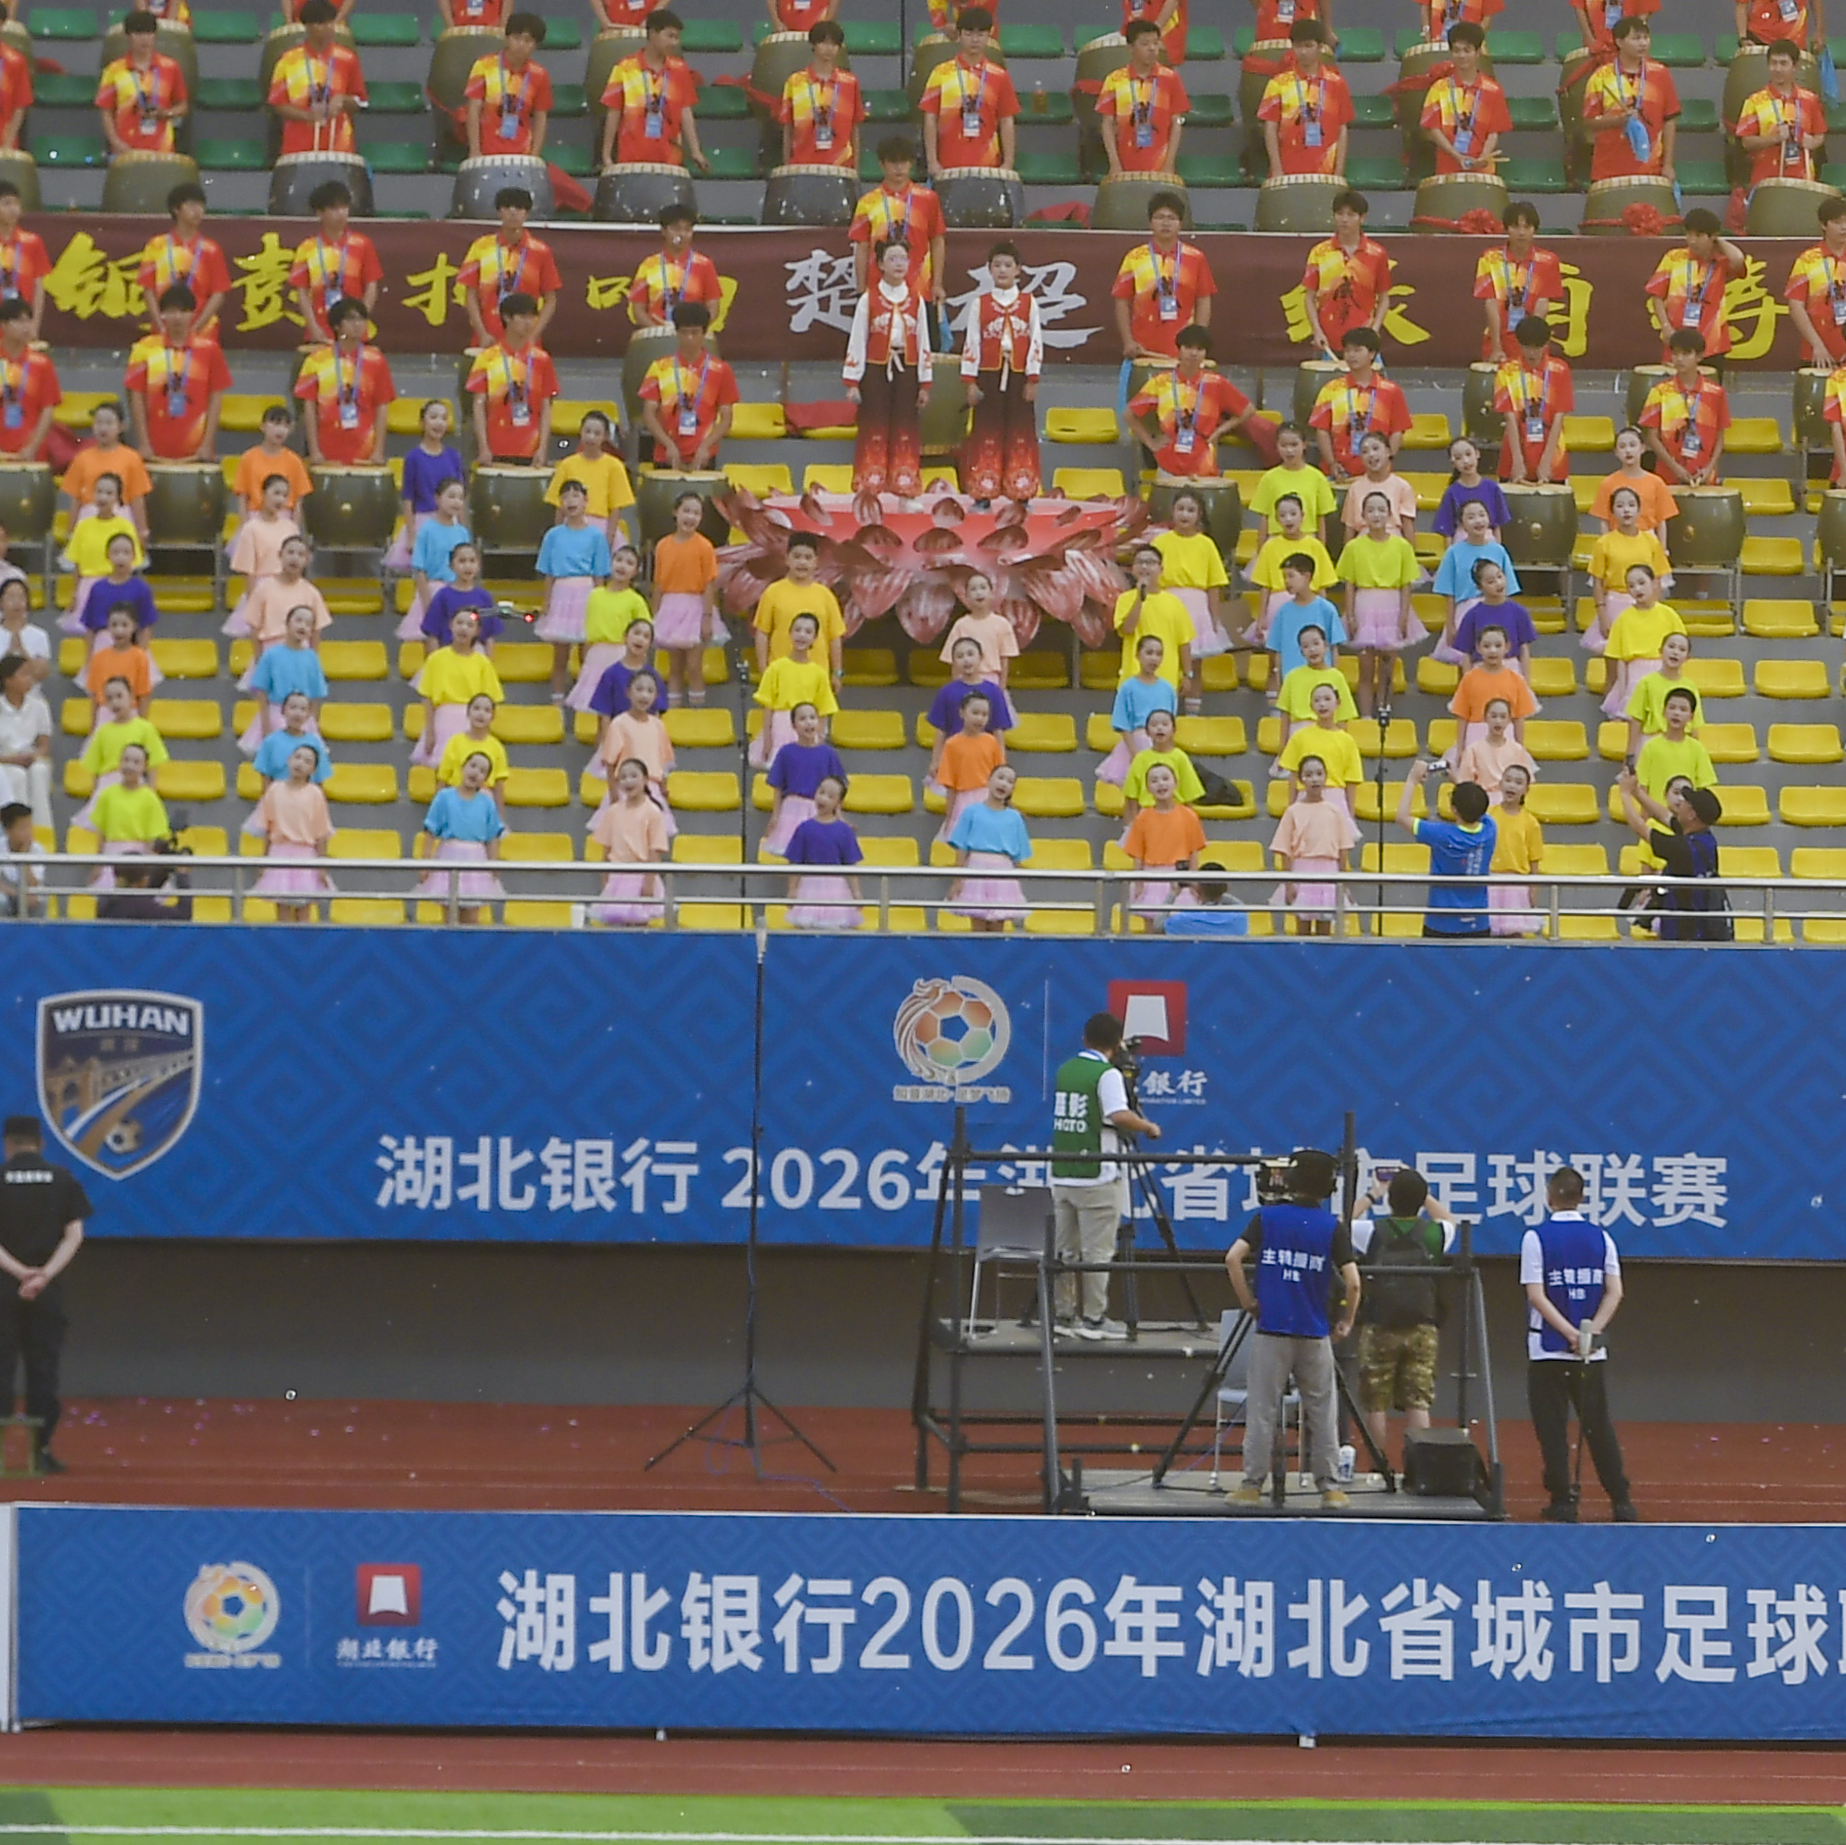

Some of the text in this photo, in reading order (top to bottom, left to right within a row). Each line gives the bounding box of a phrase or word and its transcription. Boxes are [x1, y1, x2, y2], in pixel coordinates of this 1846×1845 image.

[52, 1004, 190, 1036] WUHAN
[1054, 1118, 1087, 1133] HOTO
[375, 1135, 699, 1215] 湖北银行
